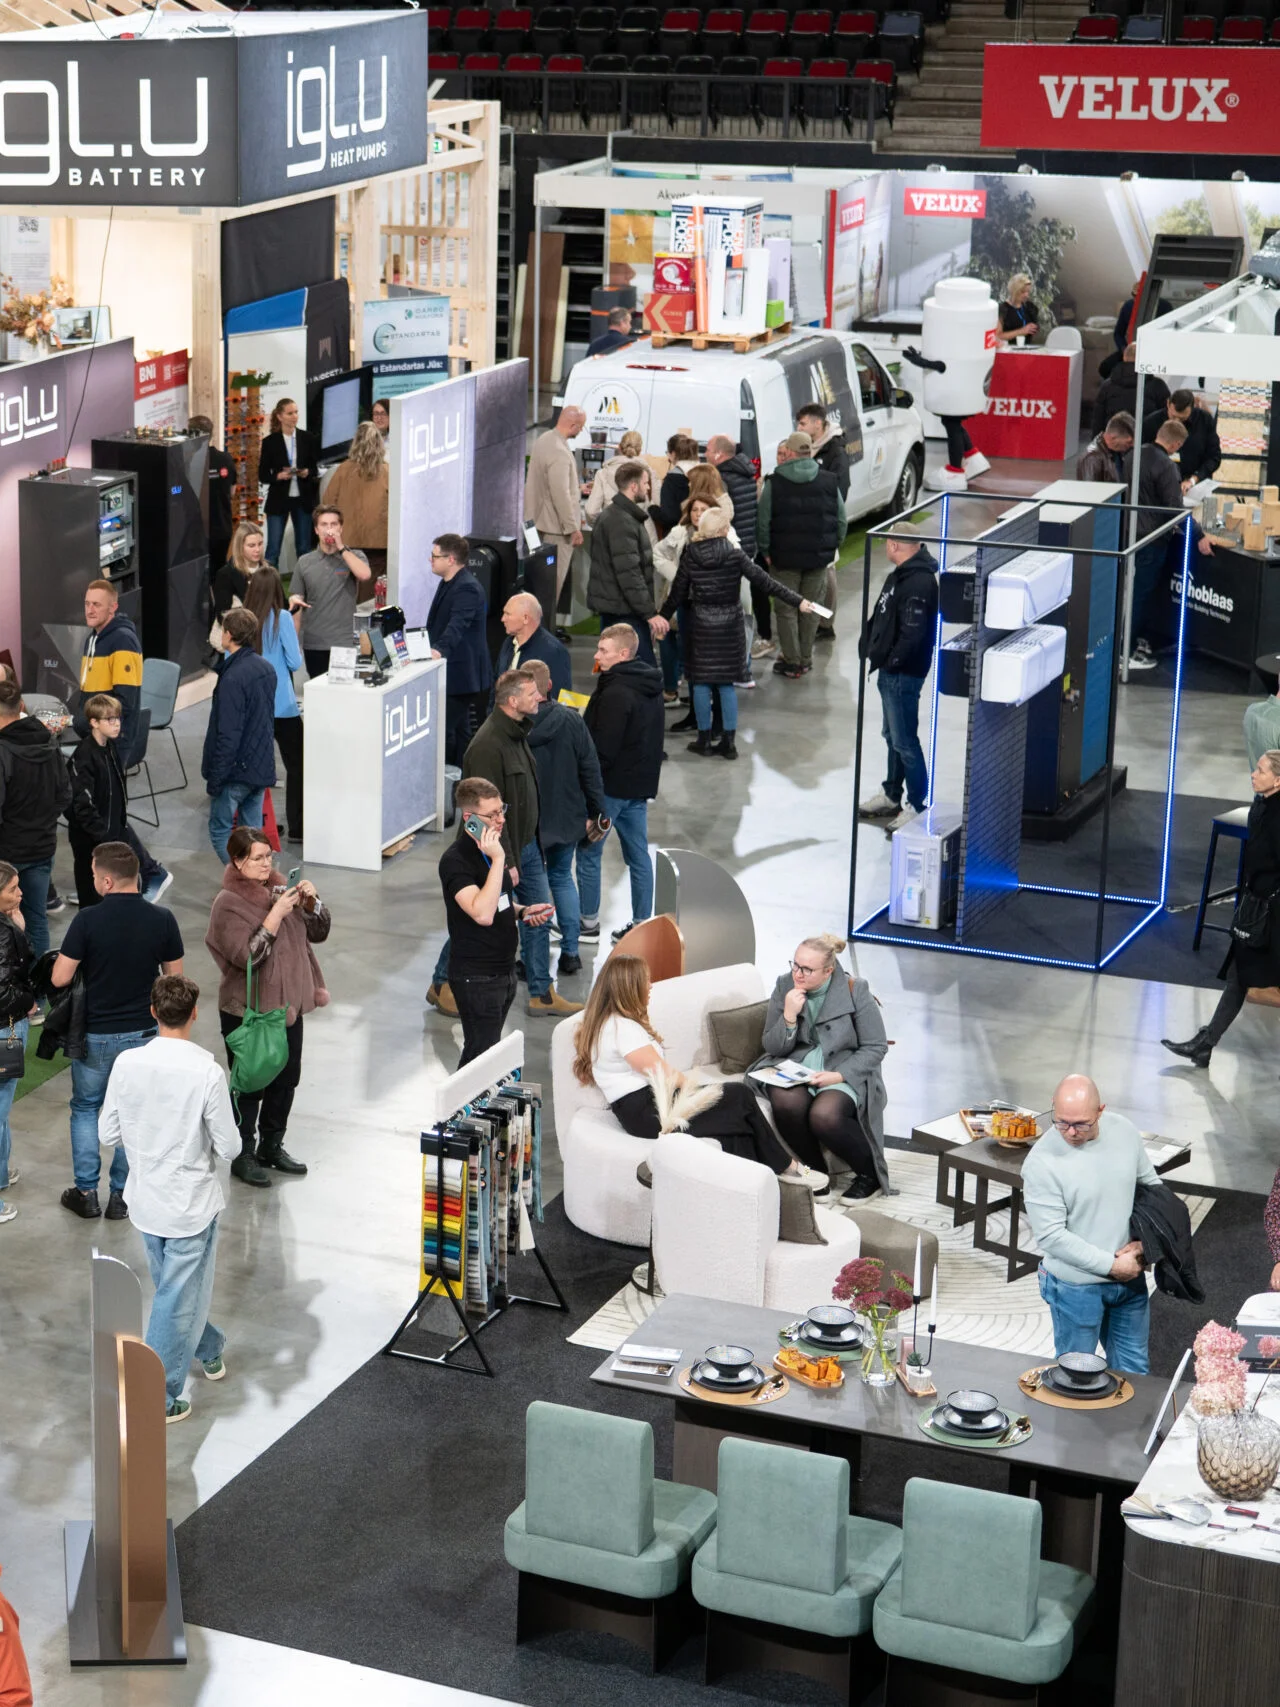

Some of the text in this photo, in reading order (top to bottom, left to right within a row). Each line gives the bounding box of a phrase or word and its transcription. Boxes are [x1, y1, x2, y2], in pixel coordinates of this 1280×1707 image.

[330, 141, 387, 168] HEAT PUMPS
[69, 168, 206, 186] BATTERY
[1140, 363, 1167, 374] SC-14
[1170, 577, 1234, 612] rohoblaas
